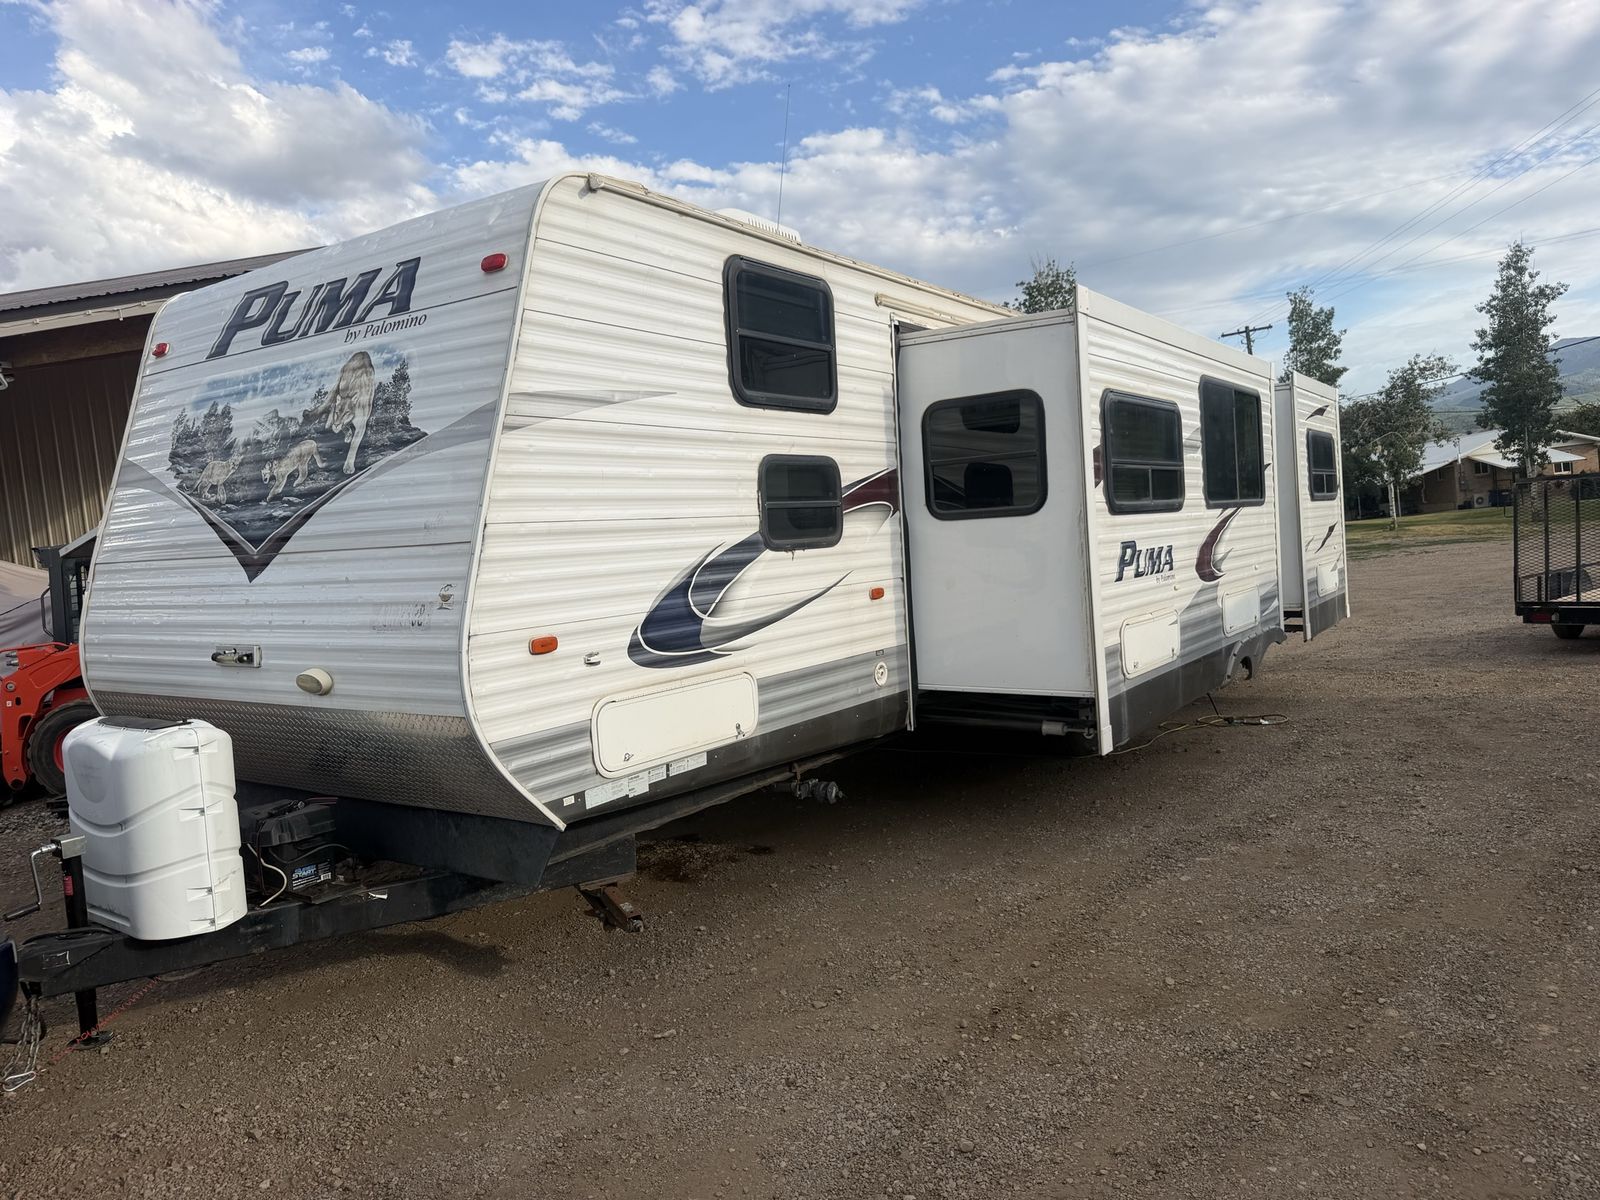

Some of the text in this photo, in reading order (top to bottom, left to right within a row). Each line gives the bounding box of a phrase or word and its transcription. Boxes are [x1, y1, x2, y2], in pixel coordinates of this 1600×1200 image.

[206, 256, 421, 360] PUMA
[344, 313, 427, 344] by Palomino
[1114, 540, 1174, 583] PUMA
